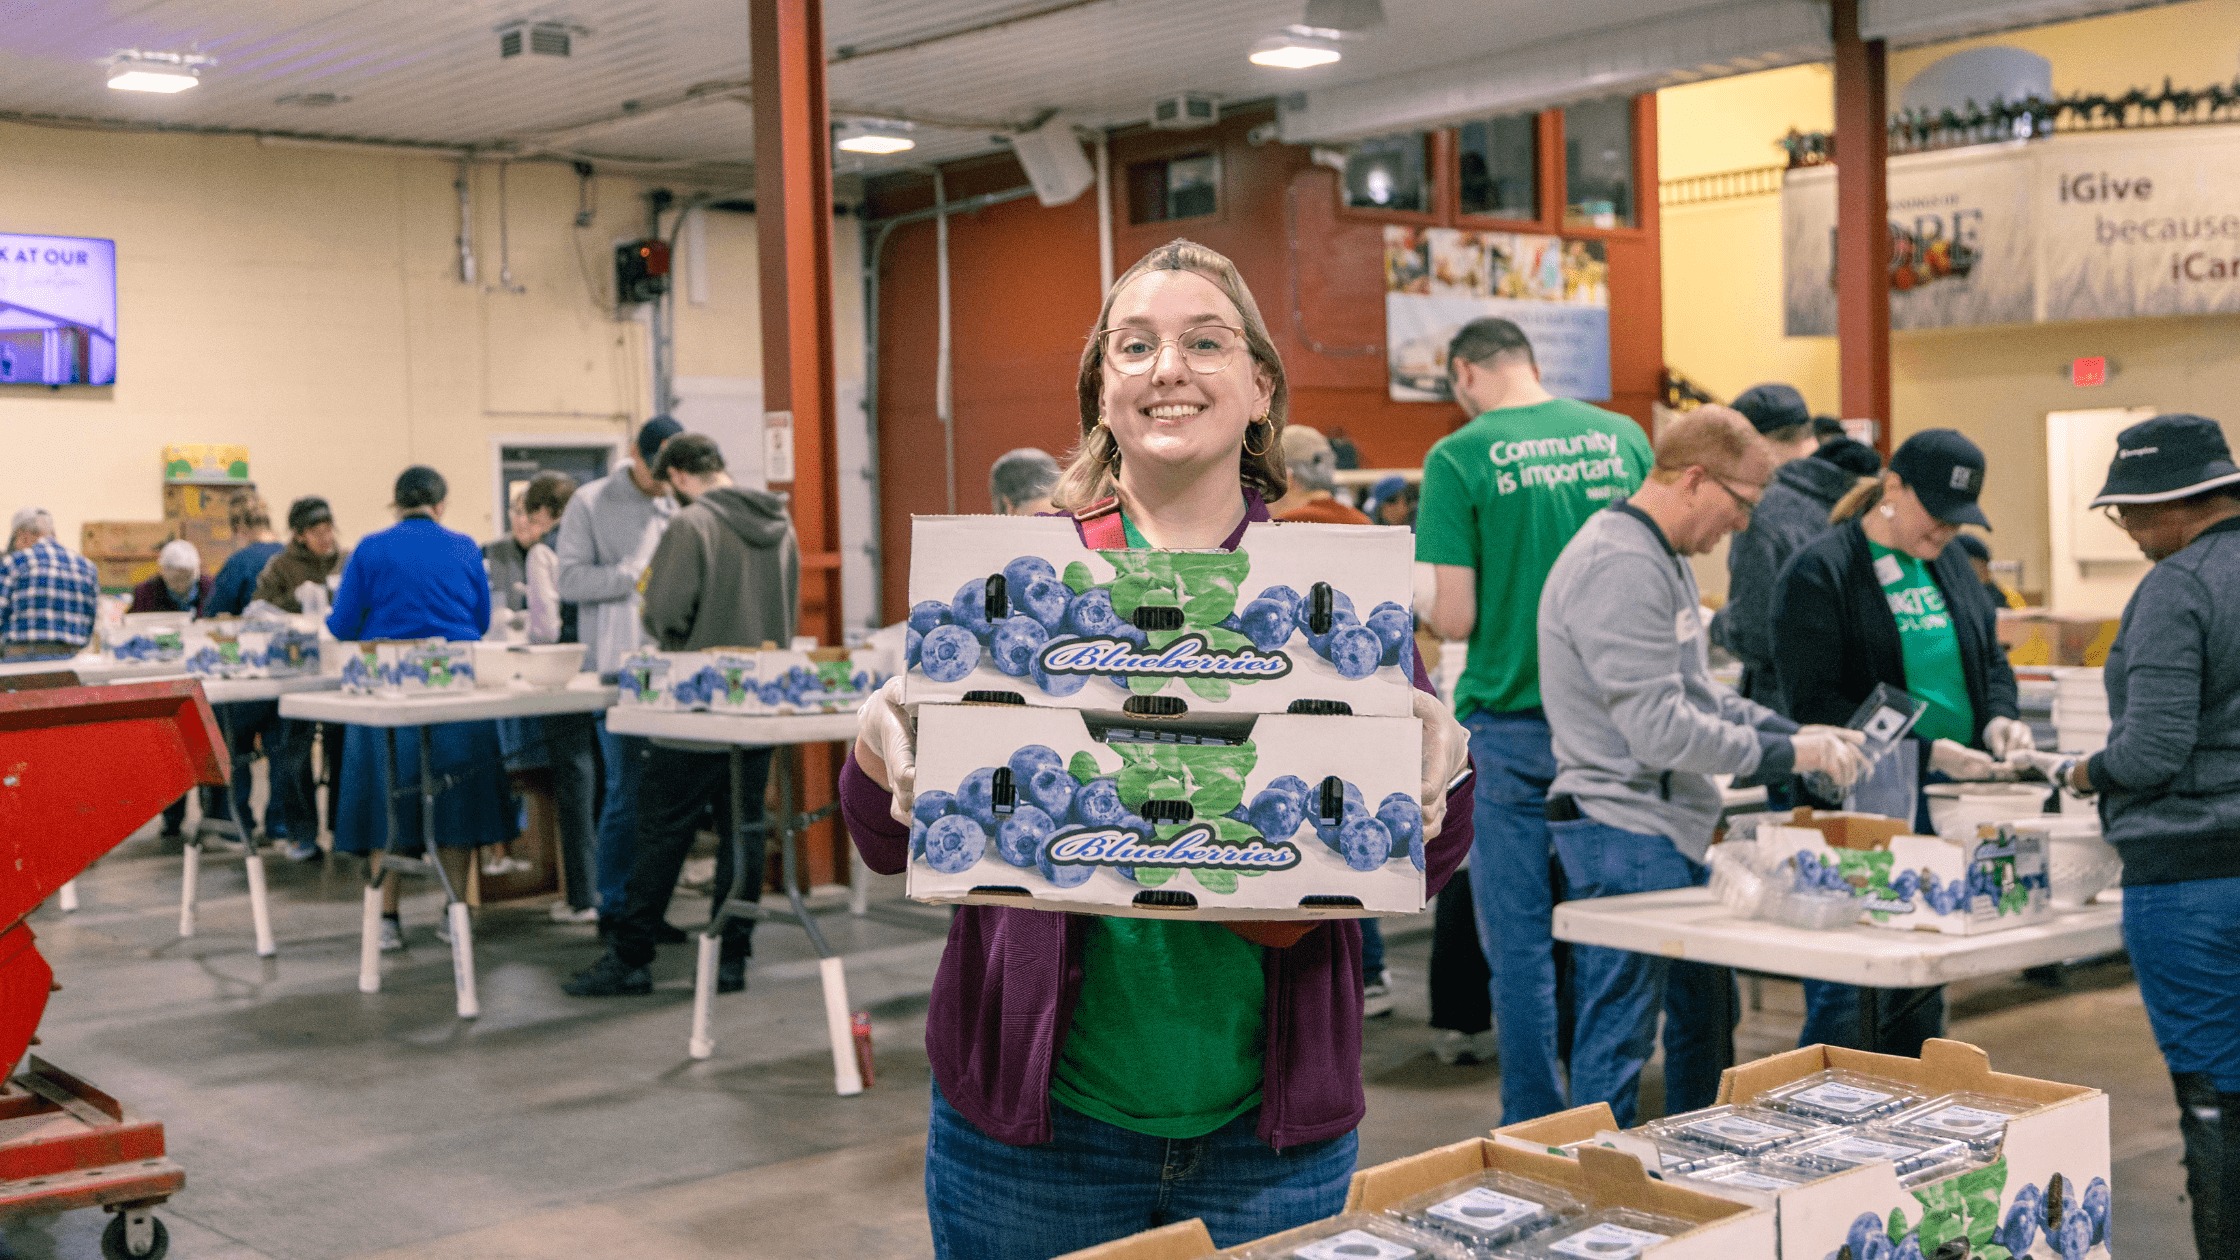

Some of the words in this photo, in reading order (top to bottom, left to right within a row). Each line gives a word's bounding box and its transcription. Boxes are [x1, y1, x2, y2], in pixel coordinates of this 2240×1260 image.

[2060, 172, 2153, 203] iGive
[2095, 214, 2240, 247] because
[15, 247, 39, 263] AT
[44, 248, 88, 266] OUR
[1489, 429, 1617, 466] Community
[1496, 470, 1517, 495] is
[1047, 640, 1285, 671] Blueberries
[1053, 831, 1294, 862] Blueberries
